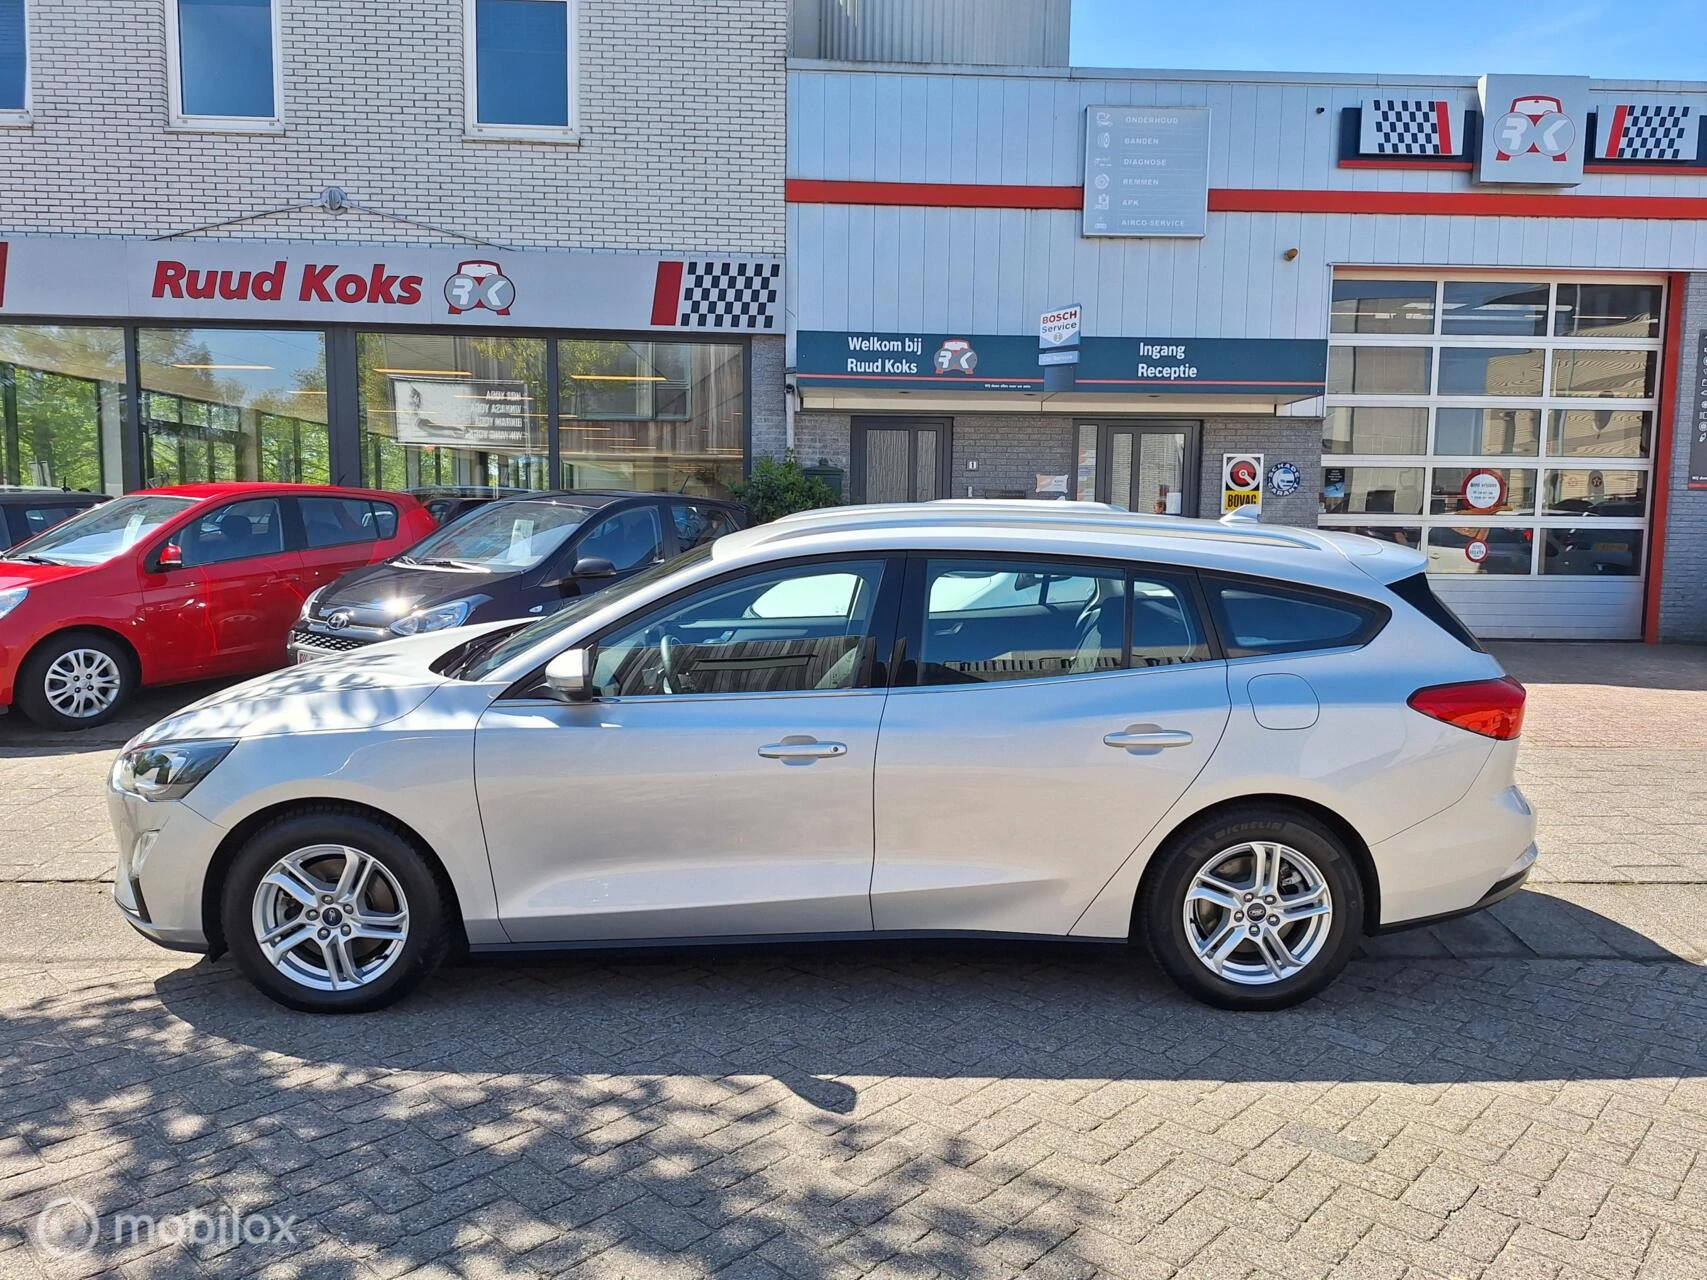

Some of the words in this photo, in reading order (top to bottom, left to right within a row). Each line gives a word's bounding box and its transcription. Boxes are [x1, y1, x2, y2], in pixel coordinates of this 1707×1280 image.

[1125, 116, 1179, 124] ONDERHOUD
[1123, 158, 1167, 166] DIAGNOSE
[1122, 178, 1159, 186] REMMEN
[1122, 199, 1140, 207] APK
[152, 260, 288, 301] Ruud
[299, 263, 423, 305] Koks
[1042, 309, 1077, 325] BOSCH
[1041, 322, 1077, 334] Service
[848, 336, 902, 352] Welkom
[905, 338, 922, 355] bij
[1139, 342, 1186, 360] Ingang
[847, 358, 882, 373] Ruud
[885, 359, 918, 373] Koks
[1137, 363, 1198, 380] Receptie
[1268, 463, 1300, 478] SCHADE
[1268, 482, 1299, 497] GARANT
[1227, 494, 1257, 508] BOVAG
